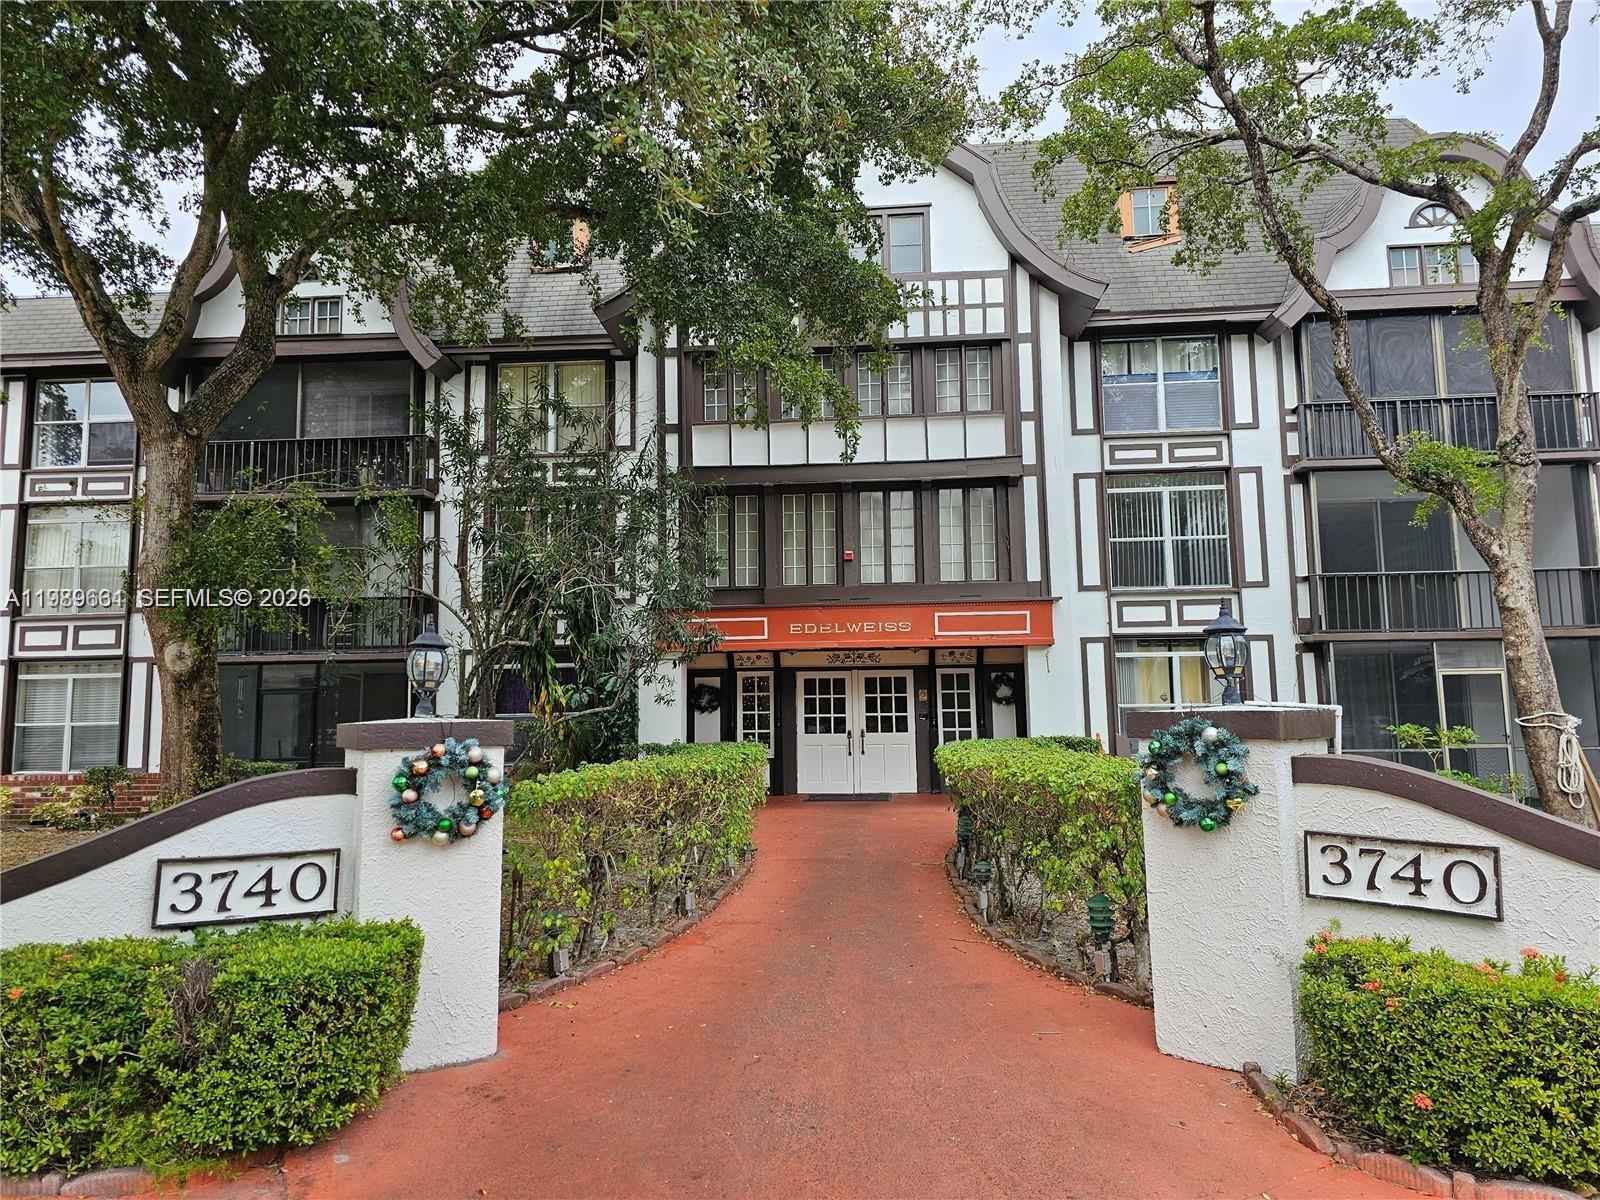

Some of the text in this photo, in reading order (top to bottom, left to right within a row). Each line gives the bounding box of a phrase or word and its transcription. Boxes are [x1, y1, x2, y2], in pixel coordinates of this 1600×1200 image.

[789, 621, 912, 634] EDELWEISS
[169, 862, 327, 914] 3740
[1320, 844, 1488, 905] 3740
